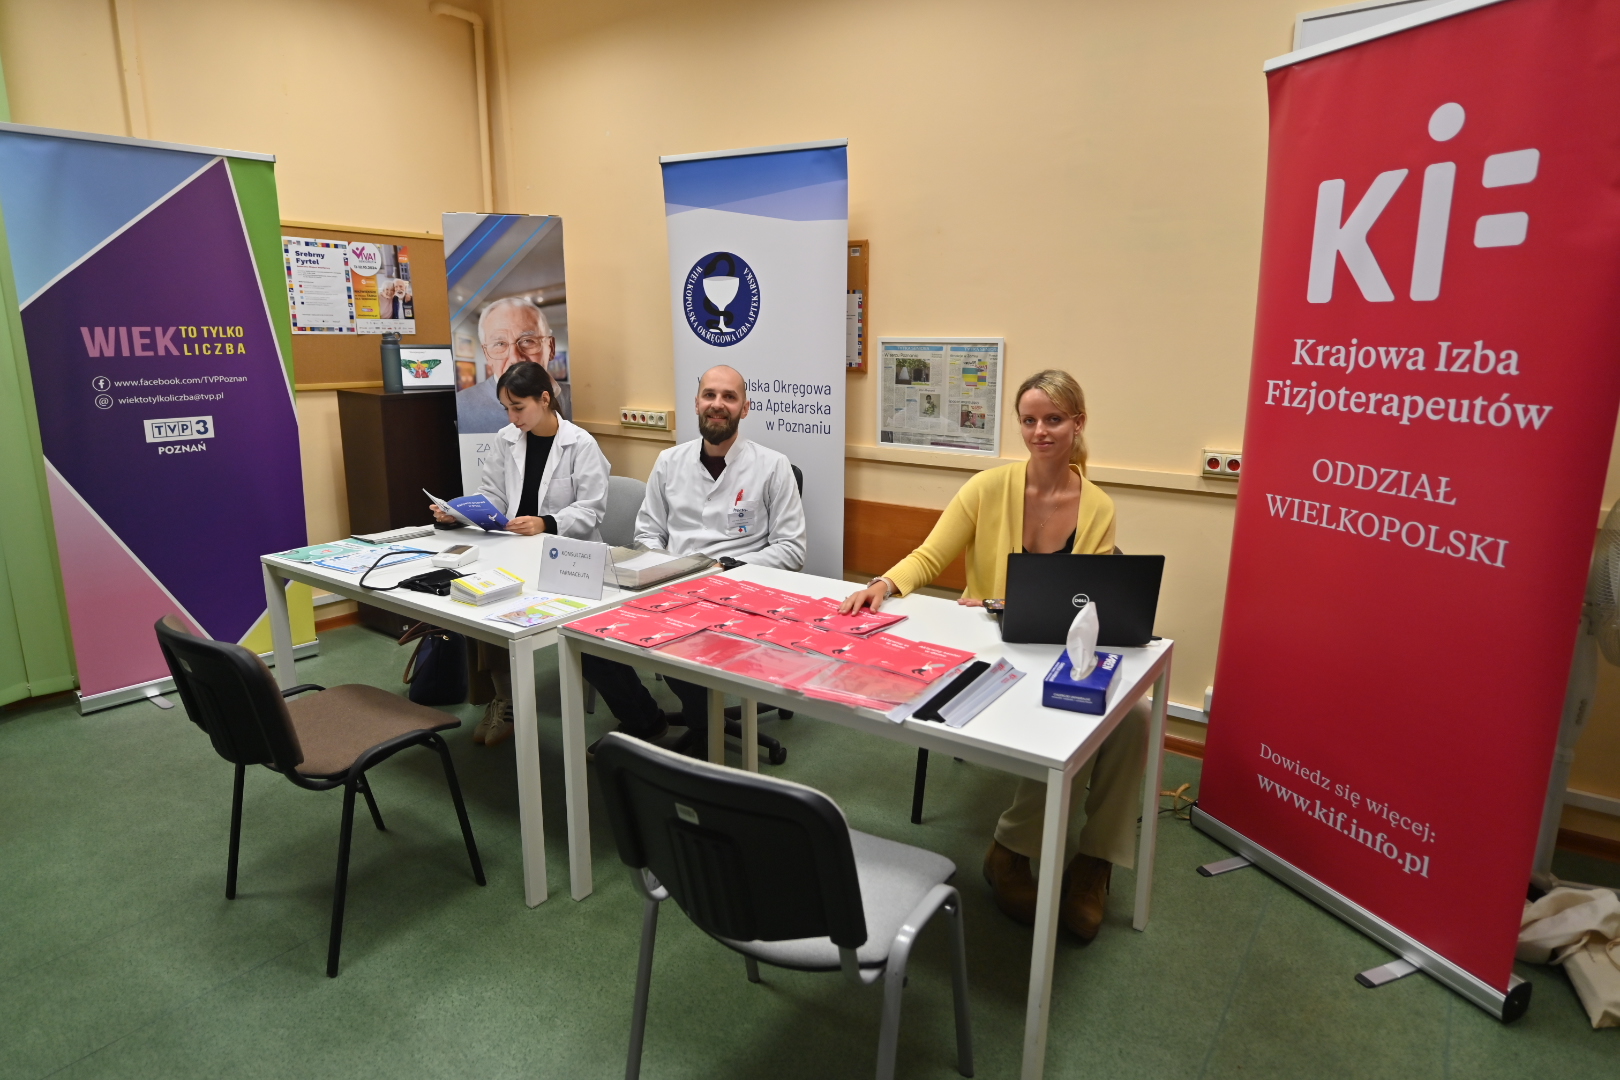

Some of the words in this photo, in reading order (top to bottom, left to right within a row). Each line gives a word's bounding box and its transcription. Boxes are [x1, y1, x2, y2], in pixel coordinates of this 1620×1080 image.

[295, 250, 325, 260] Srebrny
[296, 258, 320, 266] Fyrtel
[686, 266, 703, 328] WIELKOPOLSKA
[697, 324, 736, 344] OKRĘGOWA
[736, 322, 751, 338] IZBA
[744, 267, 758, 324] APTEKARSKA
[80, 326, 180, 358] WIEK
[179, 326, 198, 338] TO
[201, 326, 244, 338] TYLKO
[184, 342, 246, 356] LICZBA
[1292, 338, 1426, 374] Krajowa
[1434, 340, 1520, 376] Izba
[114, 376, 248, 387] www.facebook.com/TVPPoznan
[774, 380, 831, 398] Okręgowa
[118, 392, 224, 404] wiektotylkoliczba@tvp.pl
[766, 398, 831, 416] Aptekarska
[1264, 380, 1553, 431] Fizjoterapeutów
[153, 422, 191, 438] TVP
[196, 420, 208, 435] 3
[766, 420, 774, 431] w
[778, 419, 831, 434] Poznaniu
[158, 441, 206, 454] POZNAŃ
[1312, 458, 1457, 506] ODDZIAŁ
[1266, 492, 1509, 568] WIELKOPOLSKI
[1260, 742, 1331, 791] Dowiedz
[1334, 784, 1360, 808] się
[1365, 796, 1436, 843] więcej:
[1257, 773, 1430, 878] www.kif.info.pl
